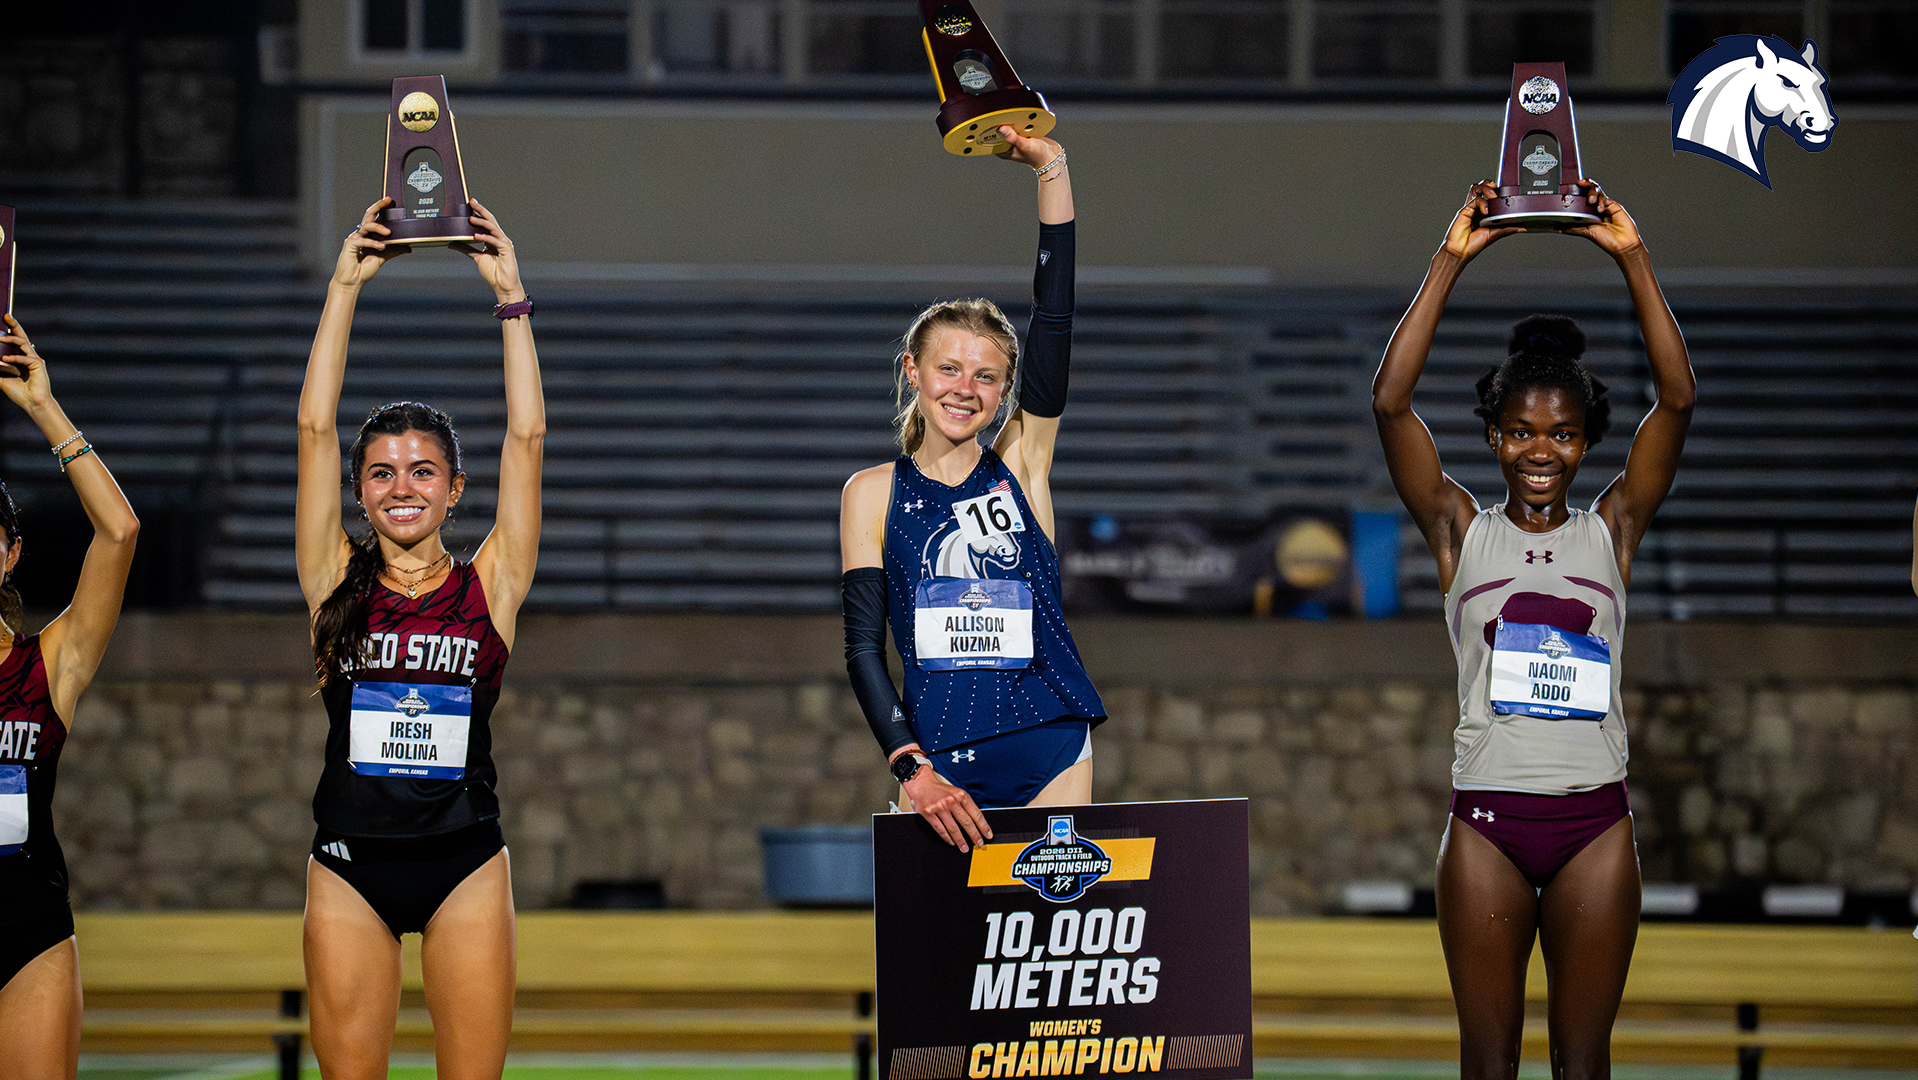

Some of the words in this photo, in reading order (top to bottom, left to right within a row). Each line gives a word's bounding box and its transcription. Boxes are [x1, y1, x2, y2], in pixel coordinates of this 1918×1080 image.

[1522, 93, 1558, 104] NCAA
[402, 111, 437, 122] NCAA
[965, 496, 1012, 537] 16
[944, 616, 1004, 633] ALLISON
[950, 636, 1001, 652] KUZMA
[405, 633, 479, 677] STATE
[1528, 662, 1577, 682] NAOMI
[1531, 683, 1571, 702] ADDO
[1551, 709, 1570, 717] KANSAS
[390, 721, 432, 739] IRESH
[0, 720, 41, 760] ATE
[381, 742, 438, 761] MOLINA
[1014, 860, 1109, 875] CHAMPIONSHIPS
[1031, 854, 1055, 862] OUTDOOR
[984, 906, 1147, 962] 10,000
[970, 957, 1161, 1010] METERS
[1029, 1018, 1102, 1038] WOMEN'S
[968, 1035, 1166, 1079] CHAMPION
